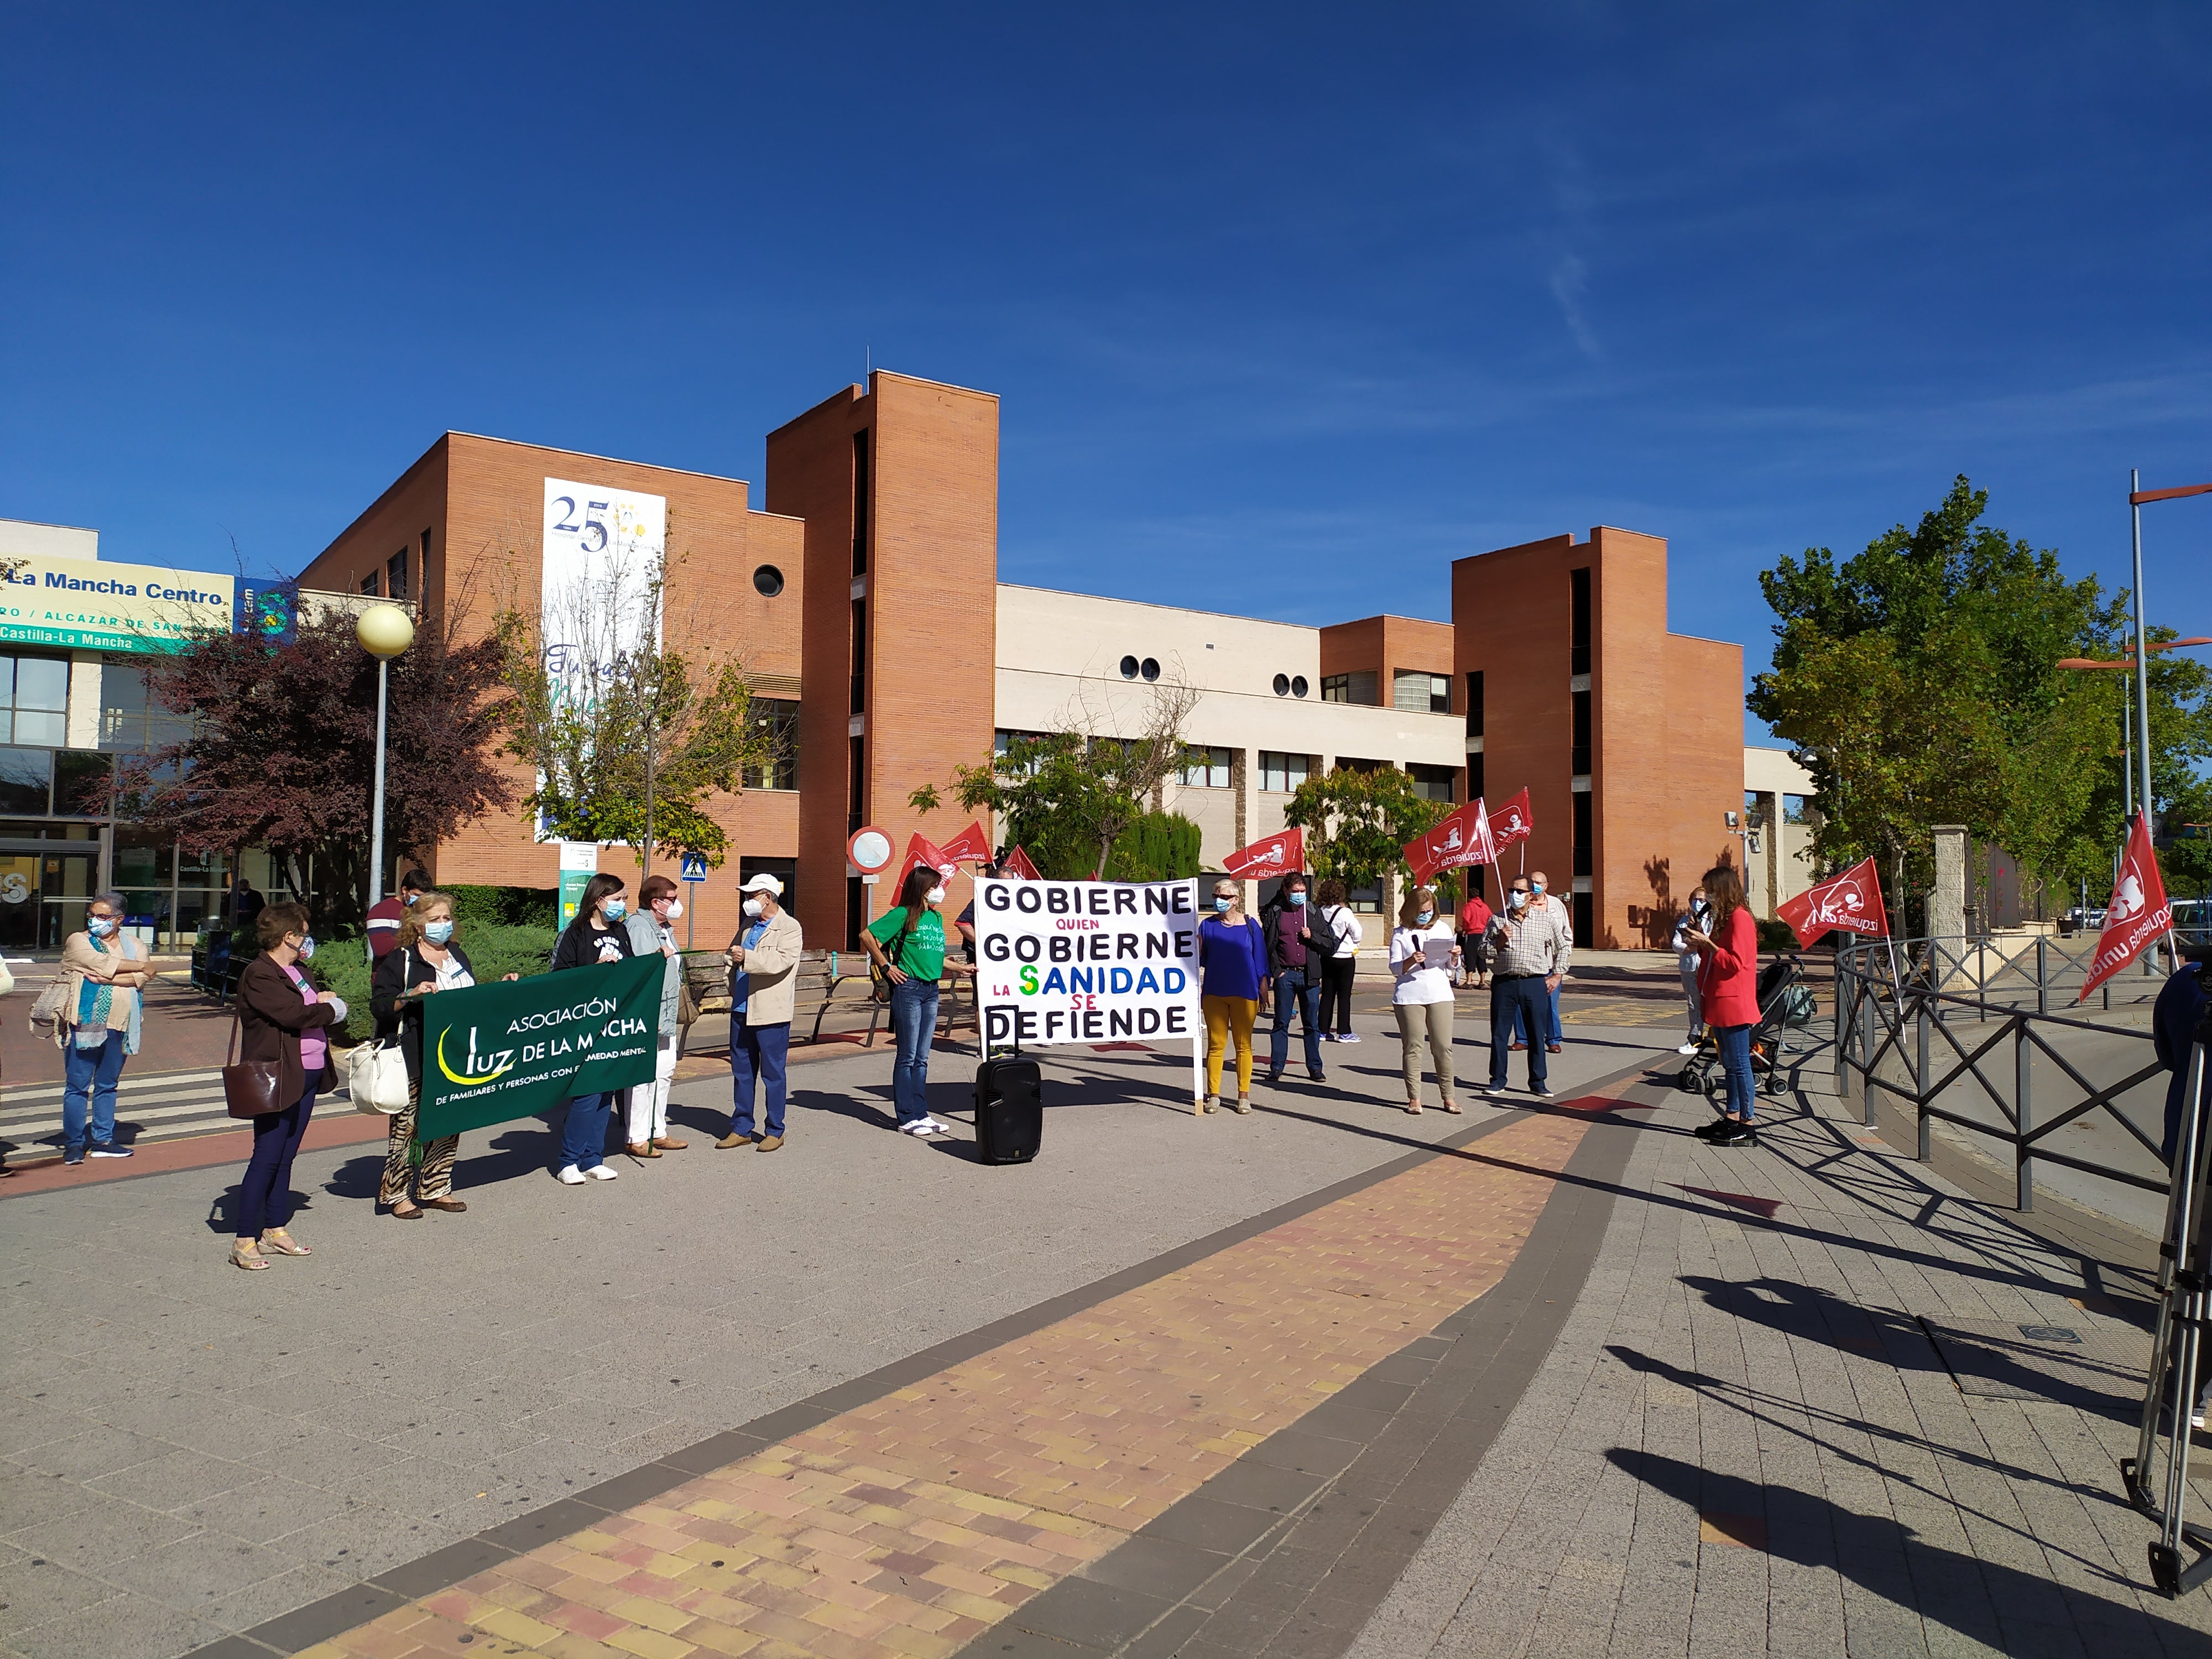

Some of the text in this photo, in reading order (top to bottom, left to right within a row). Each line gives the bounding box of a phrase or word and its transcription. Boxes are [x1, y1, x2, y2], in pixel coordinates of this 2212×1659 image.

[551, 497, 609, 552] 25
[551, 531, 576, 540] Hospital
[7, 568, 222, 605] La Mancha Centro
[44, 611, 118, 627] ALCÁZAR
[127, 618, 144, 629] DE
[0, 627, 132, 648] Castilla-La Mancha
[984, 884, 1191, 915] GOBIERNE
[1056, 919, 1099, 930] QUIEN
[984, 930, 1193, 963] GOBIERNE
[993, 965, 1186, 996] LA SANIDAD
[506, 997, 617, 1035] ASOCIACIÓN
[1070, 994, 1097, 1010] SE
[988, 1006, 1187, 1040] DEFIENDE
[523, 1042, 545, 1062] DE
[551, 1037, 572, 1057] LA
[435, 1095, 447, 1105] DE
[449, 1084, 496, 1102] FAMILIARES
[498, 1082, 504, 1091] Y
[505, 1072, 549, 1089] PERSONAS
[551, 1067, 572, 1078] CON
